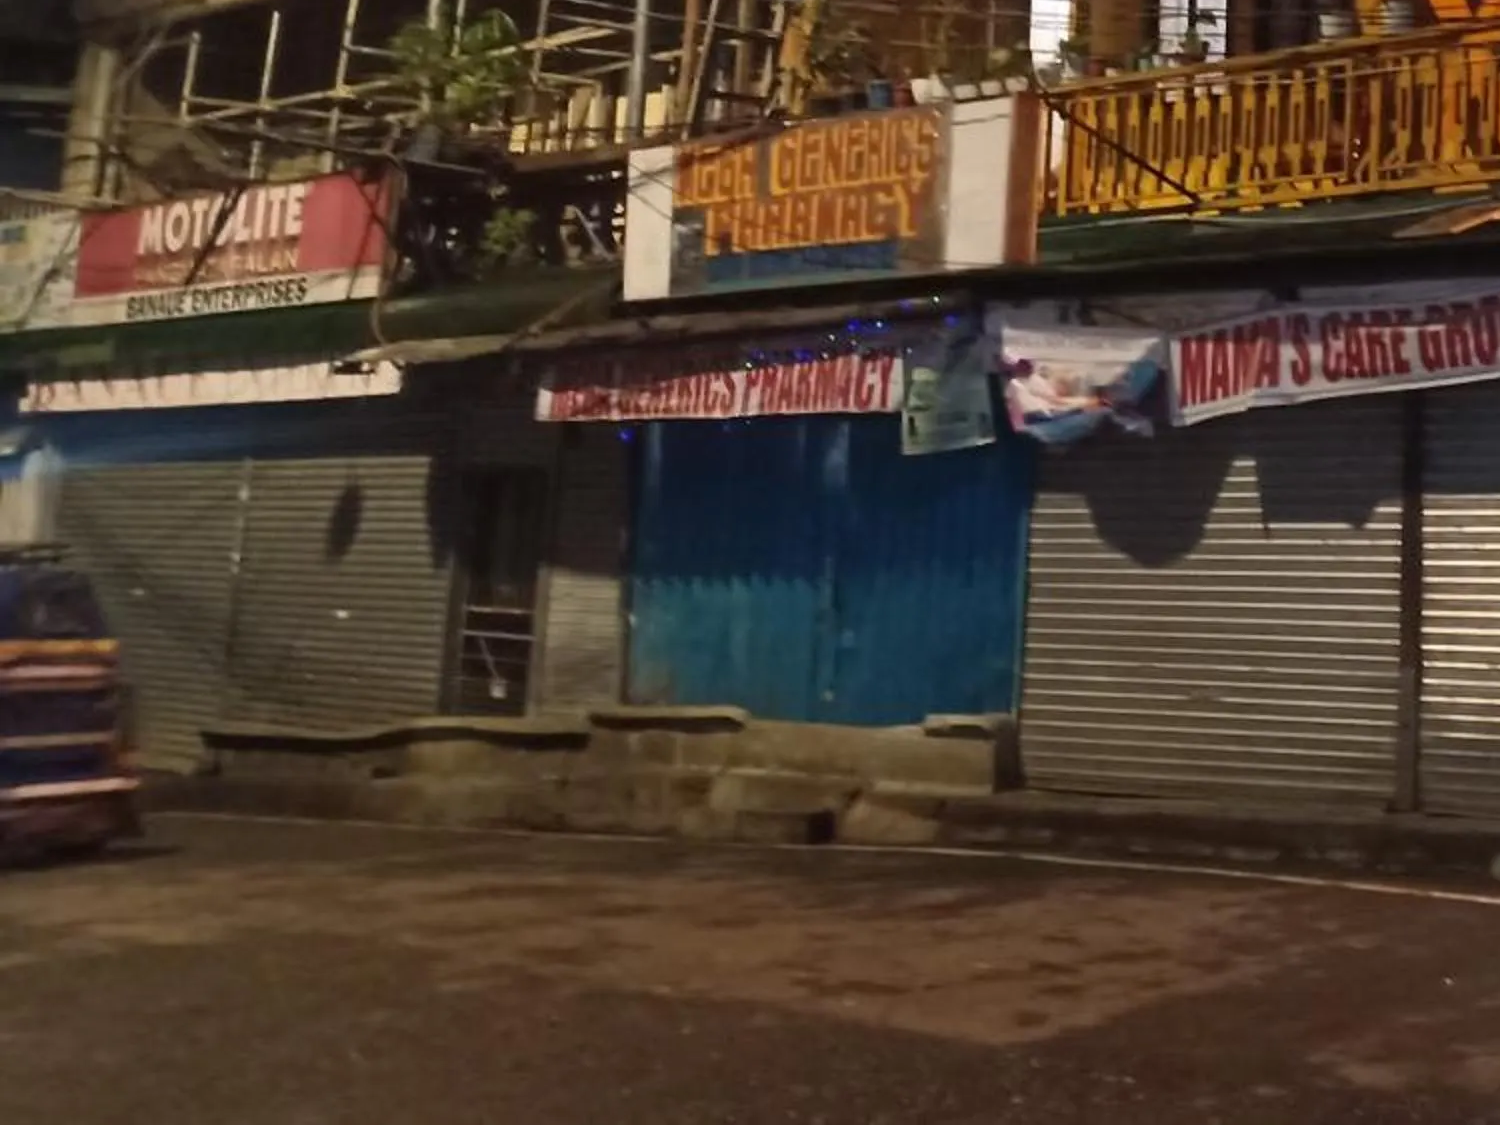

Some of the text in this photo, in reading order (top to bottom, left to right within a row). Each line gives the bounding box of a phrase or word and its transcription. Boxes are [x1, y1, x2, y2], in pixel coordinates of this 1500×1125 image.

[137, 182, 306, 255] MOTOLITE
[190, 276, 309, 313] ENTERPRISES
[742, 356, 896, 414] PHARMACY
[1178, 311, 1311, 409] MAMA'S
[1321, 309, 1412, 382] CARE
